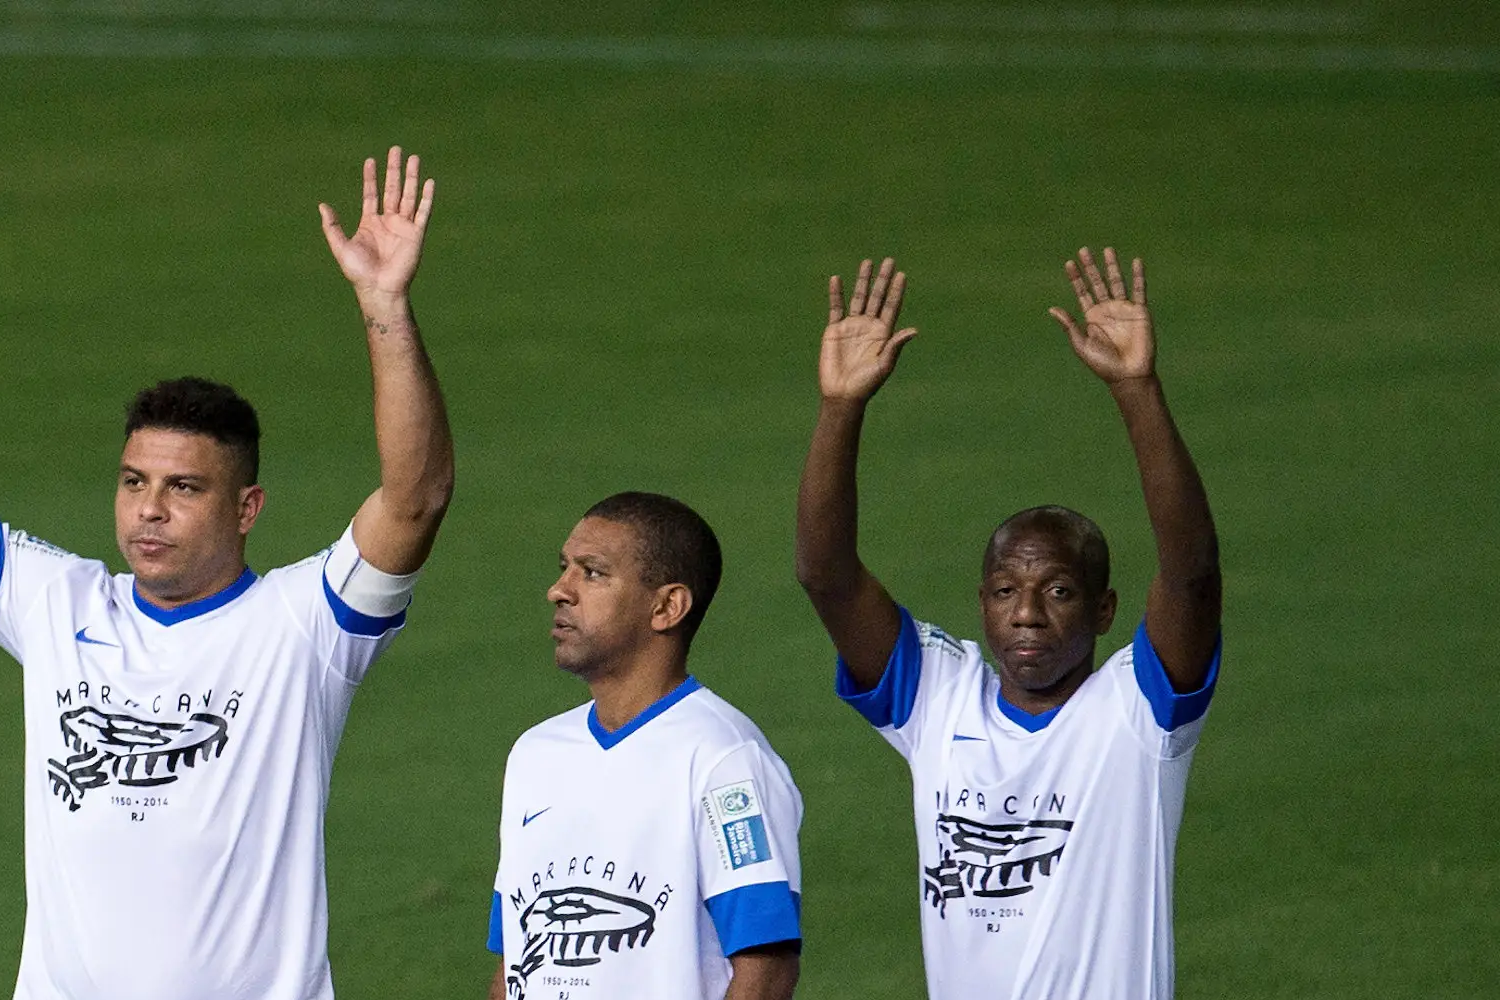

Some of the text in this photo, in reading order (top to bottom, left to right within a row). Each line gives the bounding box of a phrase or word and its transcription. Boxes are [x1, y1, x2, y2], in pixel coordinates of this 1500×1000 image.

[55, 680, 244, 719] MARCANÃ
[110, 796, 169, 807] 1950 2014
[131, 811, 145, 822] RJ
[509, 855, 674, 912] MARACANÃ
[968, 908, 1024, 918] 950 2014
[986, 923, 1001, 933] RJ
[559, 991, 570, 1000] RJ
